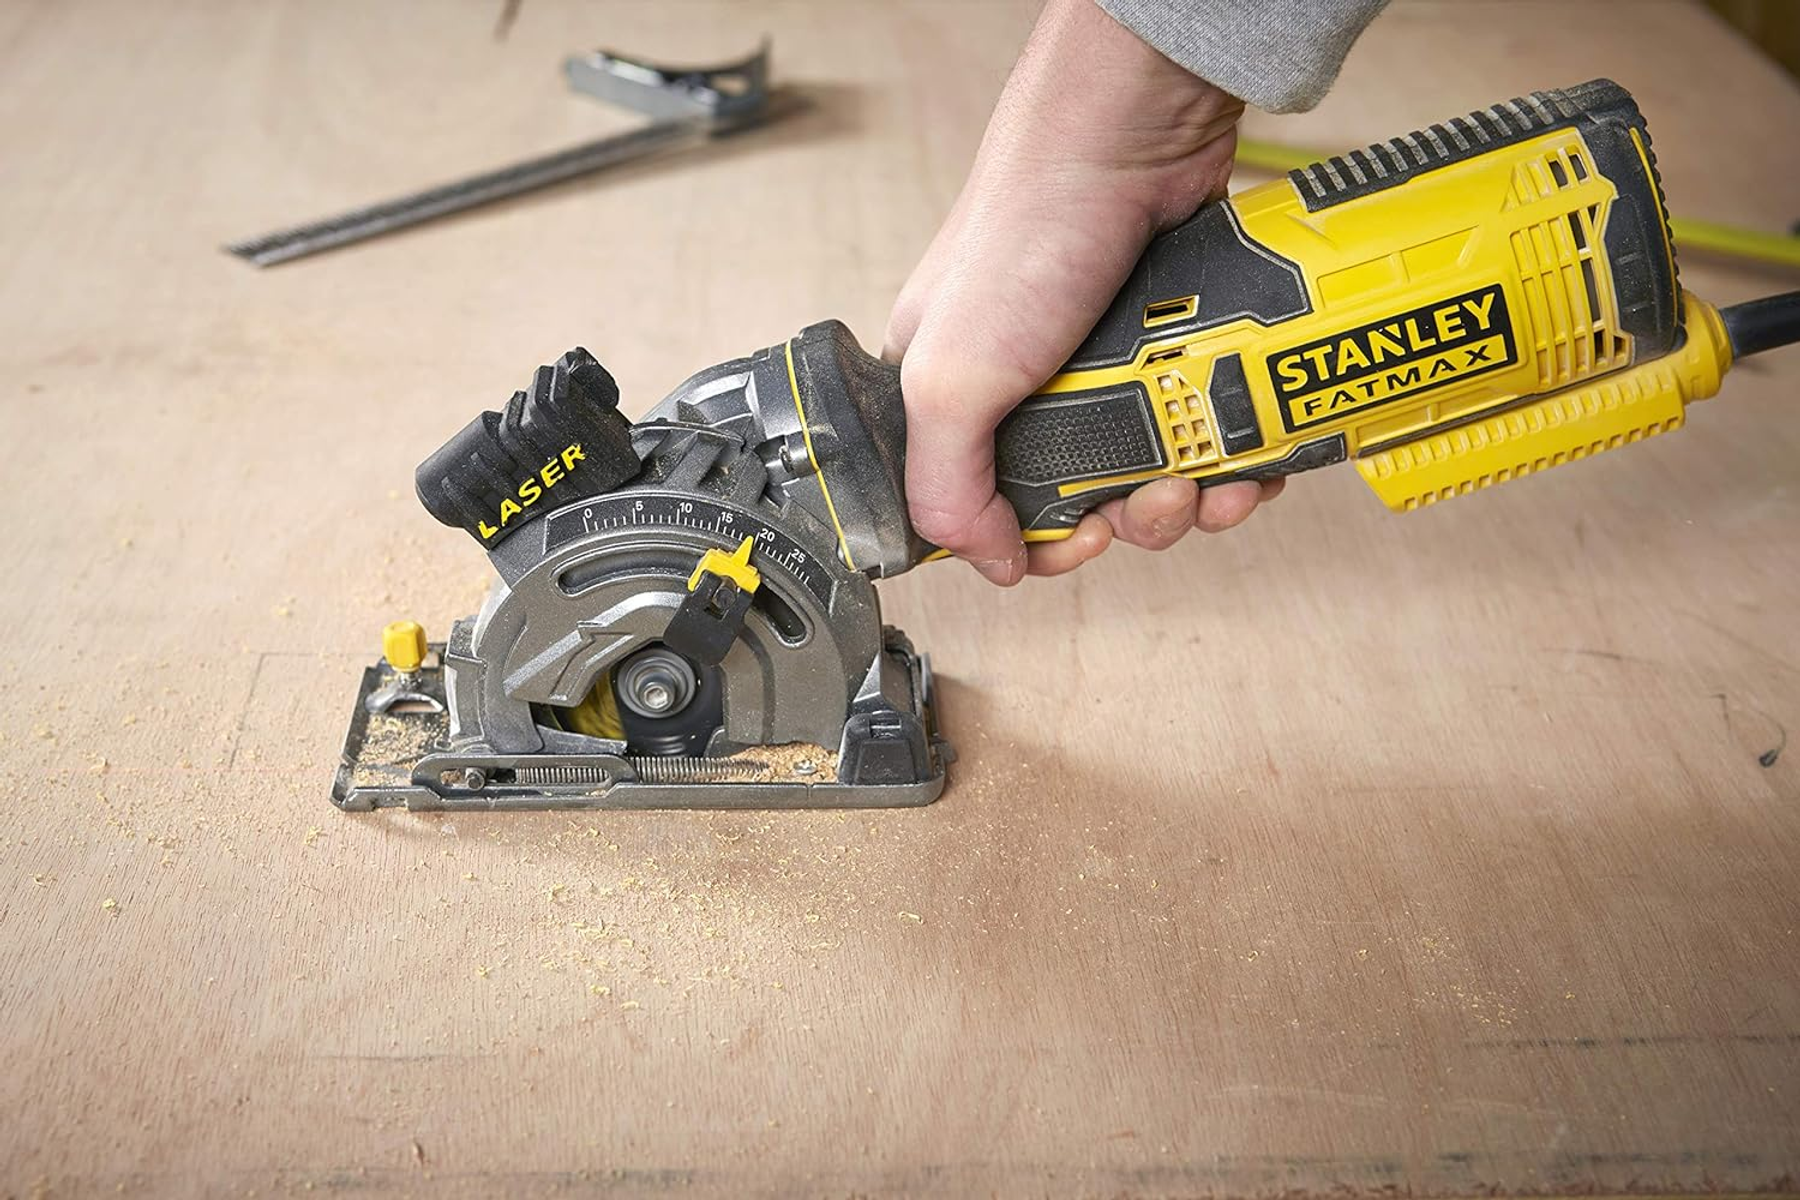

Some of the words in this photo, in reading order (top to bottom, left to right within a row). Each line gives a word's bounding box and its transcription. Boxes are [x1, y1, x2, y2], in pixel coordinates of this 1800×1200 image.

[1276, 292, 1496, 393] STANLEY
[1302, 344, 1493, 417] FATMAX
[477, 443, 586, 540] LASER
[635, 501, 644, 511] 5
[680, 502, 694, 514] 10
[721, 511, 734, 524] 15
[760, 528, 776, 542] 20
[790, 549, 806, 564] 25
